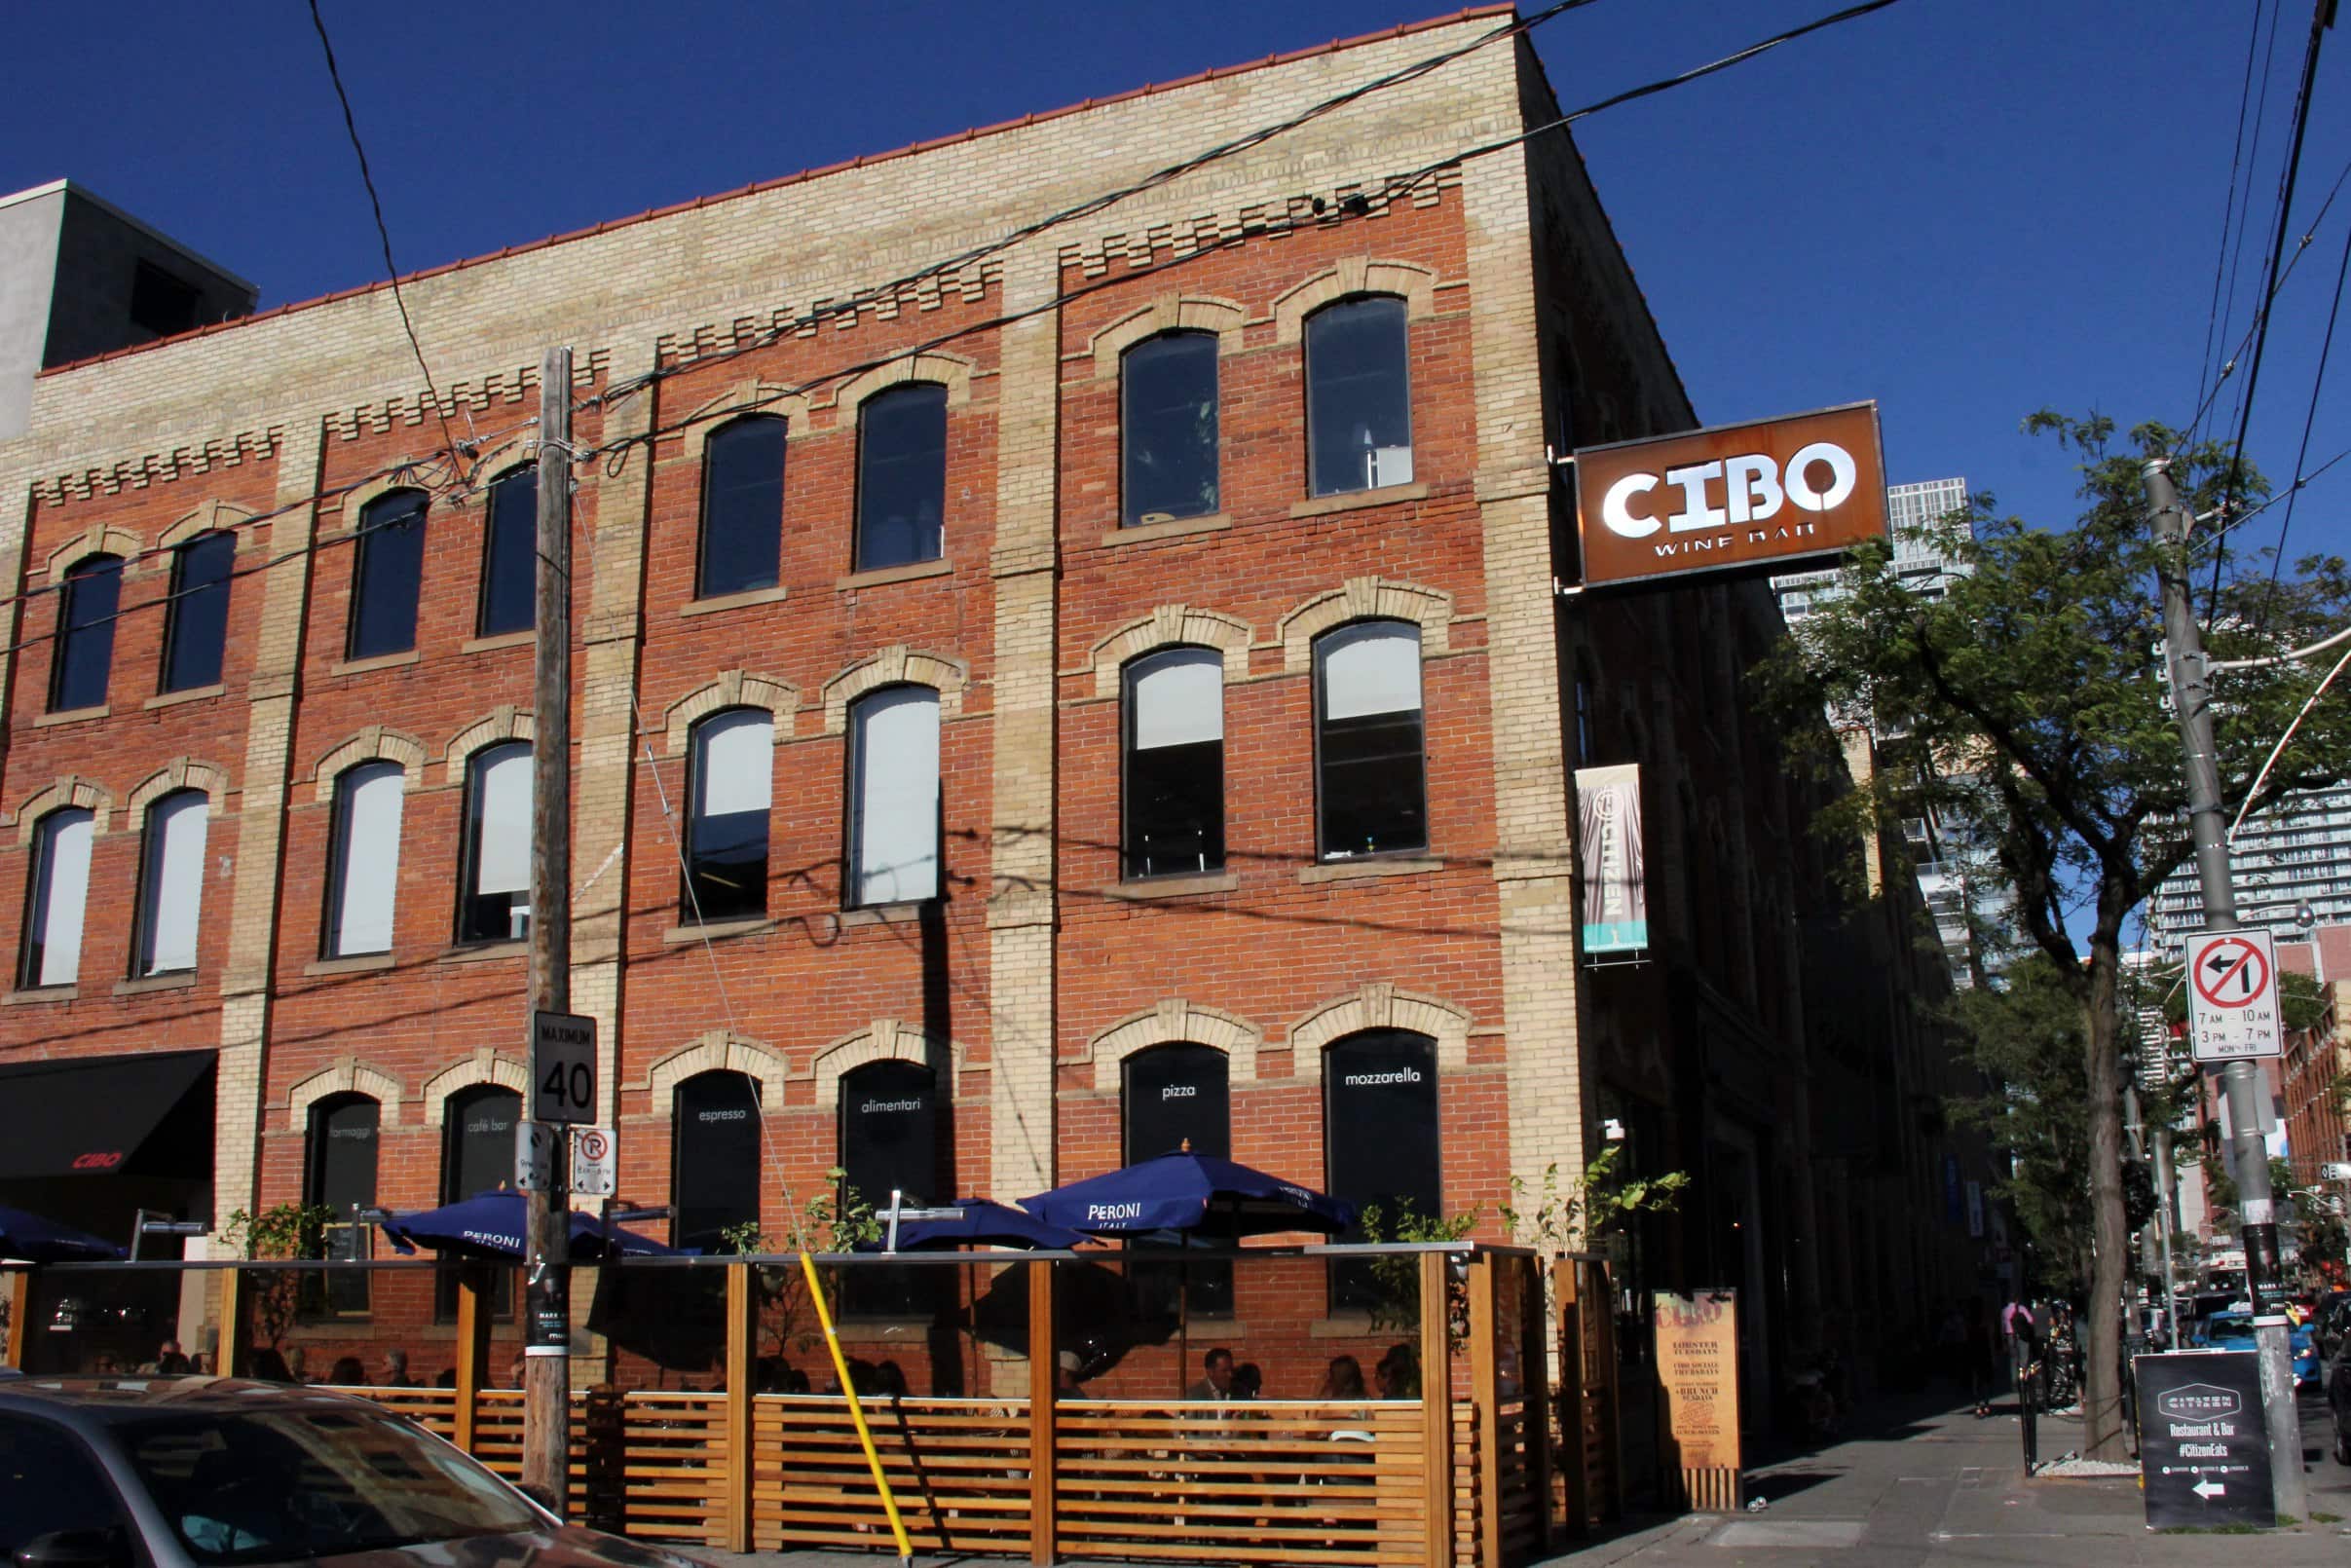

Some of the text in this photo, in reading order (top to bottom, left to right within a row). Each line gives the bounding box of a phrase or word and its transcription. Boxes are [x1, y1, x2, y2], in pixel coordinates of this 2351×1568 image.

[1603, 442, 1856, 538] CIBO
[1655, 522, 1814, 556] WINE BAR
[2199, 1012, 2206, 1025] 7
[2209, 1014, 2222, 1024] AM
[2243, 1009, 2255, 1022] 10
[2258, 1011, 2270, 1021] AM
[541, 1026, 590, 1045] MAXIMUM
[2202, 1030, 2209, 1043] 3
[2213, 1032, 2225, 1042] PM
[2246, 1027, 2253, 1040] 7
[2258, 1030, 2270, 1039] PM
[2218, 1044, 2234, 1053] MON
[1345, 1066, 1421, 1085] mozzarella
[542, 1061, 592, 1108] 40
[1162, 1084, 1196, 1101] pizza
[861, 1098, 920, 1114] alimentari
[698, 1108, 746, 1123] espresso
[467, 1119, 507, 1133] café bar
[1088, 1202, 1140, 1220] PERONI
[464, 1230, 521, 1248] PERONI
[2168, 1396, 2232, 1409] CITIZEN
[2170, 1423, 2212, 1437] Restaurant
[2220, 1422, 2234, 1436] Bar
